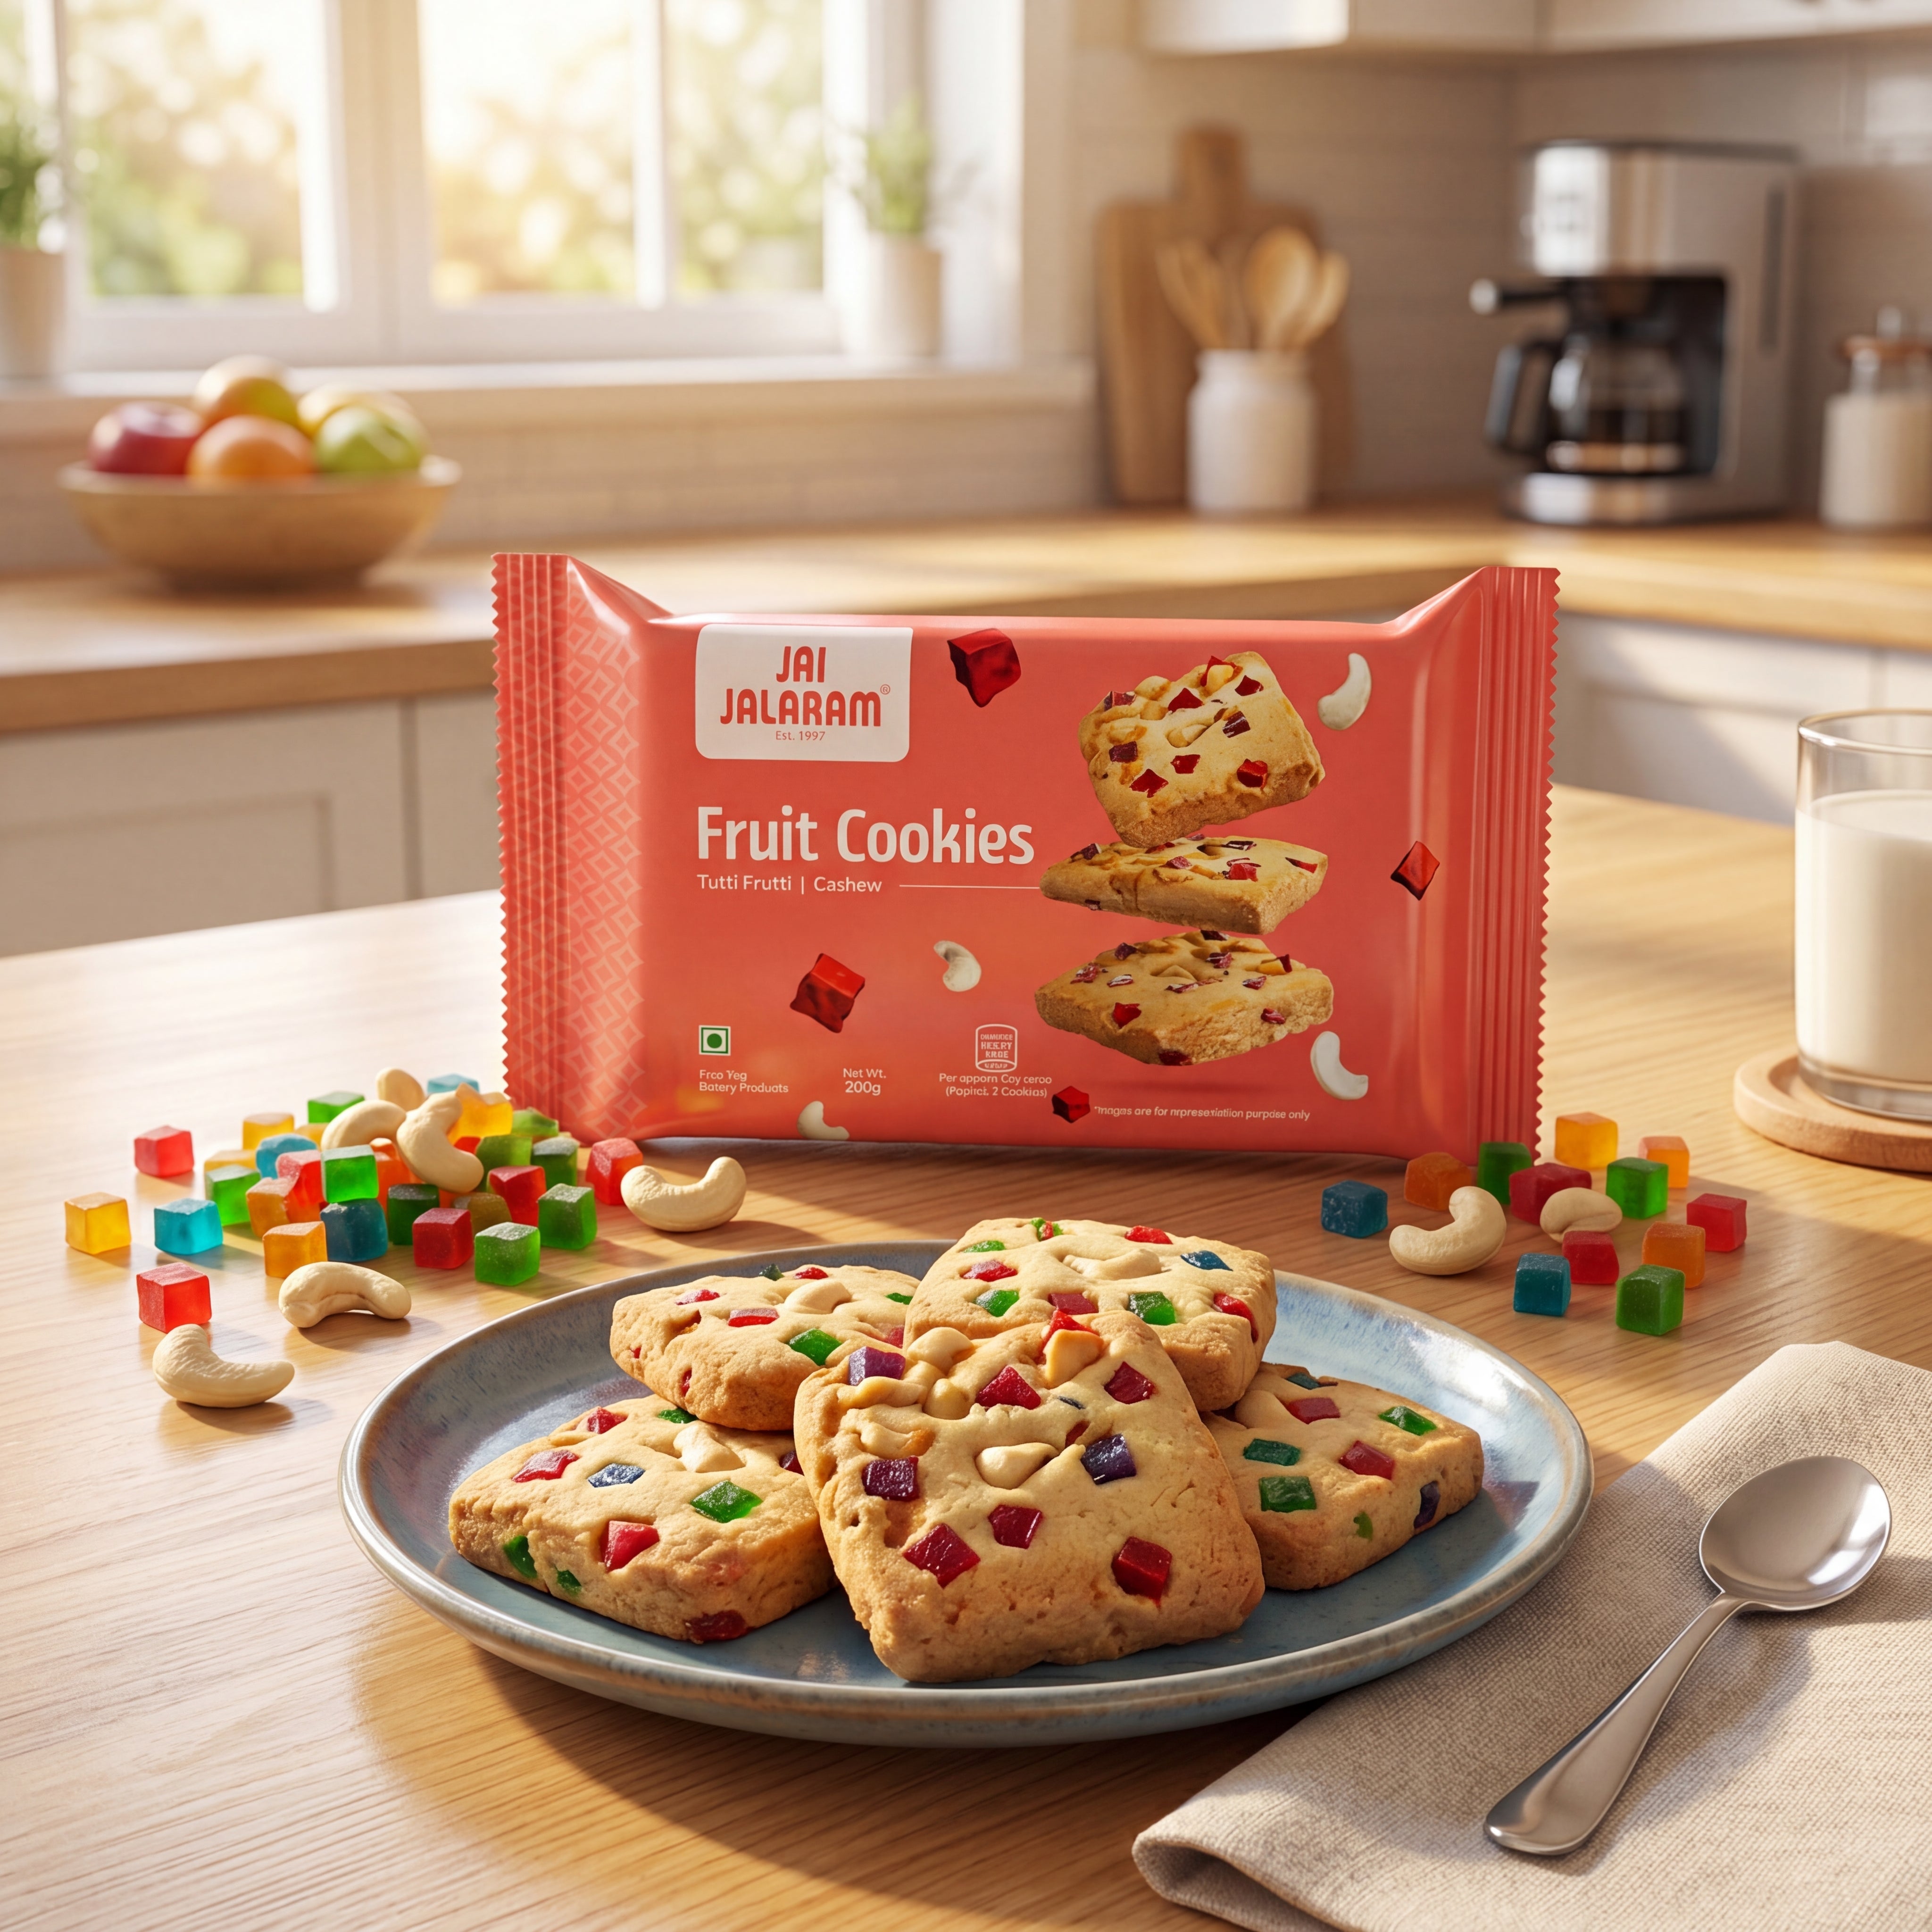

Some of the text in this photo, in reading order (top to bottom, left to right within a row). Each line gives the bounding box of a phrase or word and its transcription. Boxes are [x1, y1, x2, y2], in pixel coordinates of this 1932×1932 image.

[776, 646, 826, 683] JAI
[775, 731, 826, 741] Est. 1997
[698, 805, 1034, 865] Fruit Cookies
[697, 874, 738, 890] Tutti
[743, 875, 791, 891] Frutti
[814, 876, 882, 892] Cashew
[843, 1068, 887, 1078] Net Wt.
[939, 1073, 957, 1083] Per
[845, 1081, 881, 1096] 200g
[992, 1086, 999, 1096] 2
[1134, 1108, 1152, 1116] are
[1154, 1106, 1168, 1116] for
[1288, 1109, 1310, 1122] only
